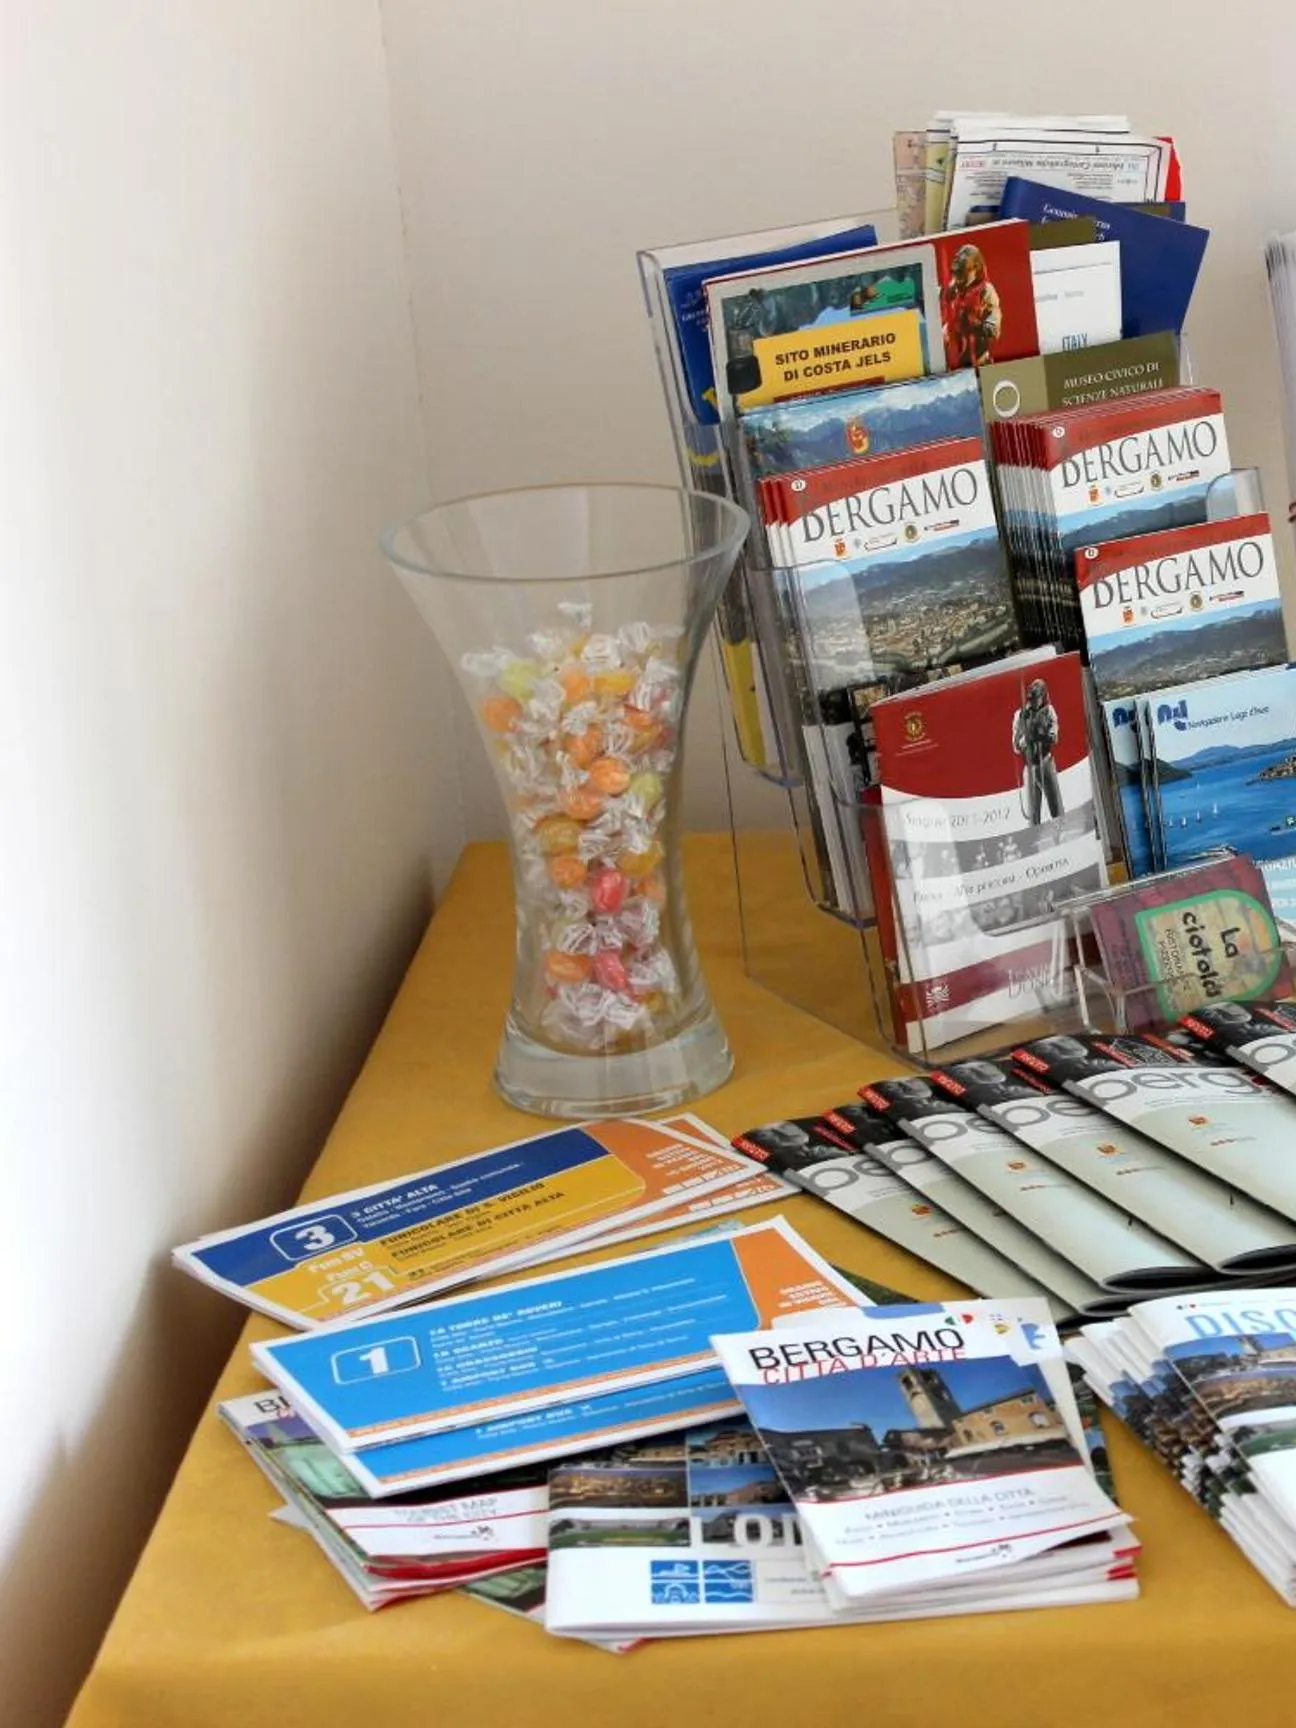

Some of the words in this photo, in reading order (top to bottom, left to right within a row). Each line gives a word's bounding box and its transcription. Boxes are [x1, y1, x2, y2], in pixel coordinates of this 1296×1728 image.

[775, 349, 810, 366] SITO
[813, 332, 897, 357] MINERARIO
[1062, 332, 1088, 350] ITALY
[784, 367, 801, 381] DI
[803, 359, 852, 378] COSTA
[856, 351, 892, 368] JELS
[1063, 369, 1102, 390] MUSEO
[1103, 362, 1146, 382] CIVICO
[1146, 361, 1161, 373] DI
[1061, 420, 1218, 489] BERGAMO
[802, 468, 979, 544] BERGAMO
[1093, 541, 1265, 610] BERGAMO
[1182, 911, 1223, 998] ciotola
[1219, 926, 1241, 959] La
[295, 1224, 335, 1251] 3
[331, 1271, 397, 1305] 21
[358, 1346, 389, 1375] 1
[749, 1327, 966, 1371] BERGAMO
